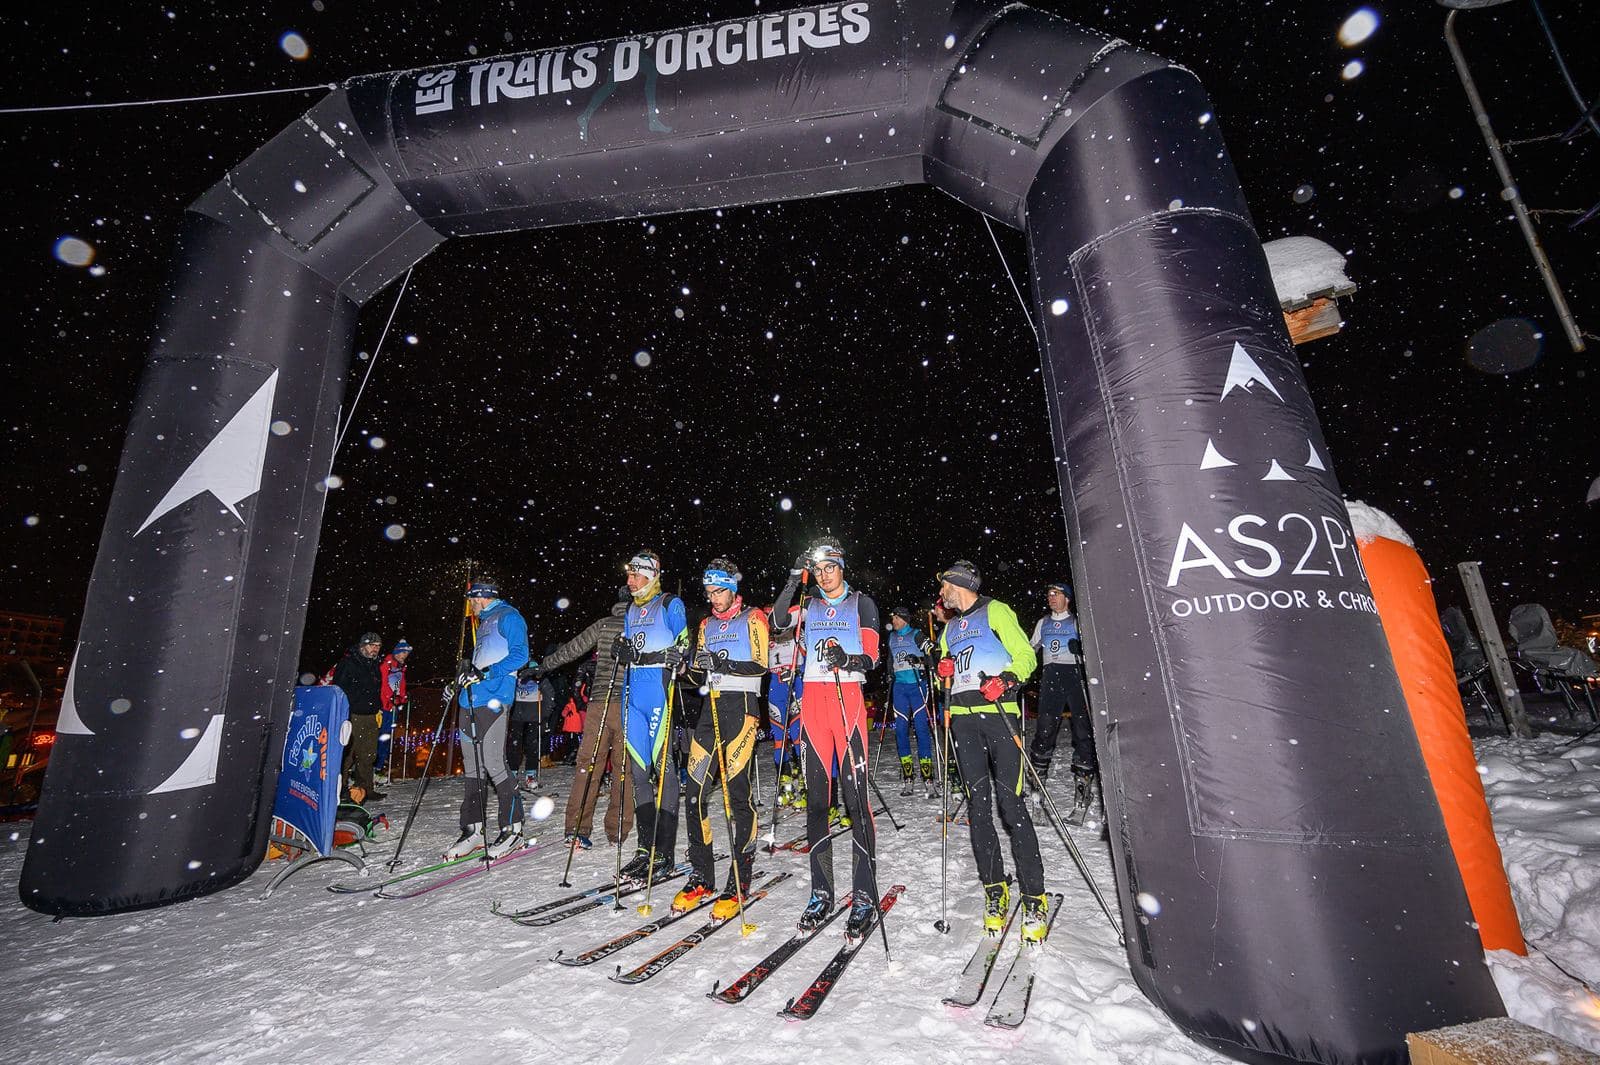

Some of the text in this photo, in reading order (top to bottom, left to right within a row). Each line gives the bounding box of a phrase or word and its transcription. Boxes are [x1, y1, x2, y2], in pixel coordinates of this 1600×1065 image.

[415, 69, 456, 115] LES
[468, 46, 600, 107] TRAILS
[1171, 590, 1380, 618] OUTDOOR & CHRO
[773, 652, 781, 665] 1
